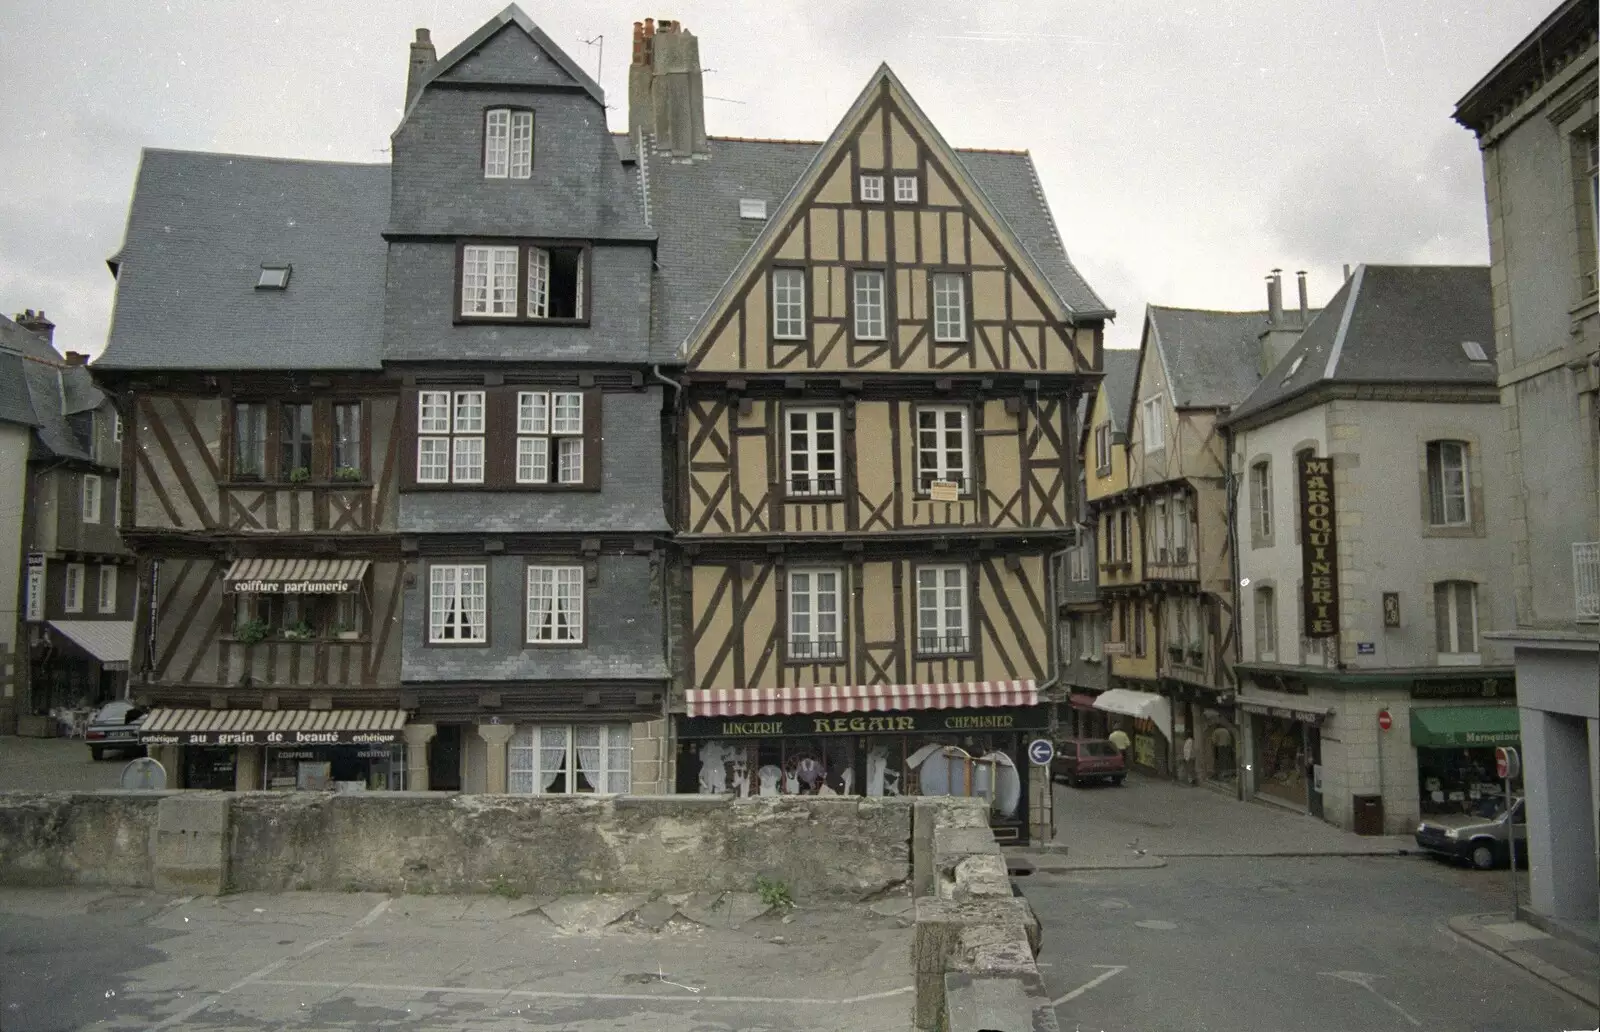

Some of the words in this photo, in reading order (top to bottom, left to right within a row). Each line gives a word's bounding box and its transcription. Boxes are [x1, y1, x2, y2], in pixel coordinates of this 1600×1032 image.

[1306, 461, 1333, 633] MAROQUINERIE
[235, 580, 279, 592] coiffure
[284, 580, 348, 593] parfumerie
[722, 722, 783, 735] LINGERIE
[813, 716, 915, 732] REGAIN
[945, 715, 1013, 729] CHEMISIER
[141, 734, 179, 743] esthétique
[190, 733, 207, 743] au
[218, 731, 254, 744] grain
[267, 731, 283, 742] de
[296, 731, 339, 742] beauté
[352, 733, 394, 742] esthétique
